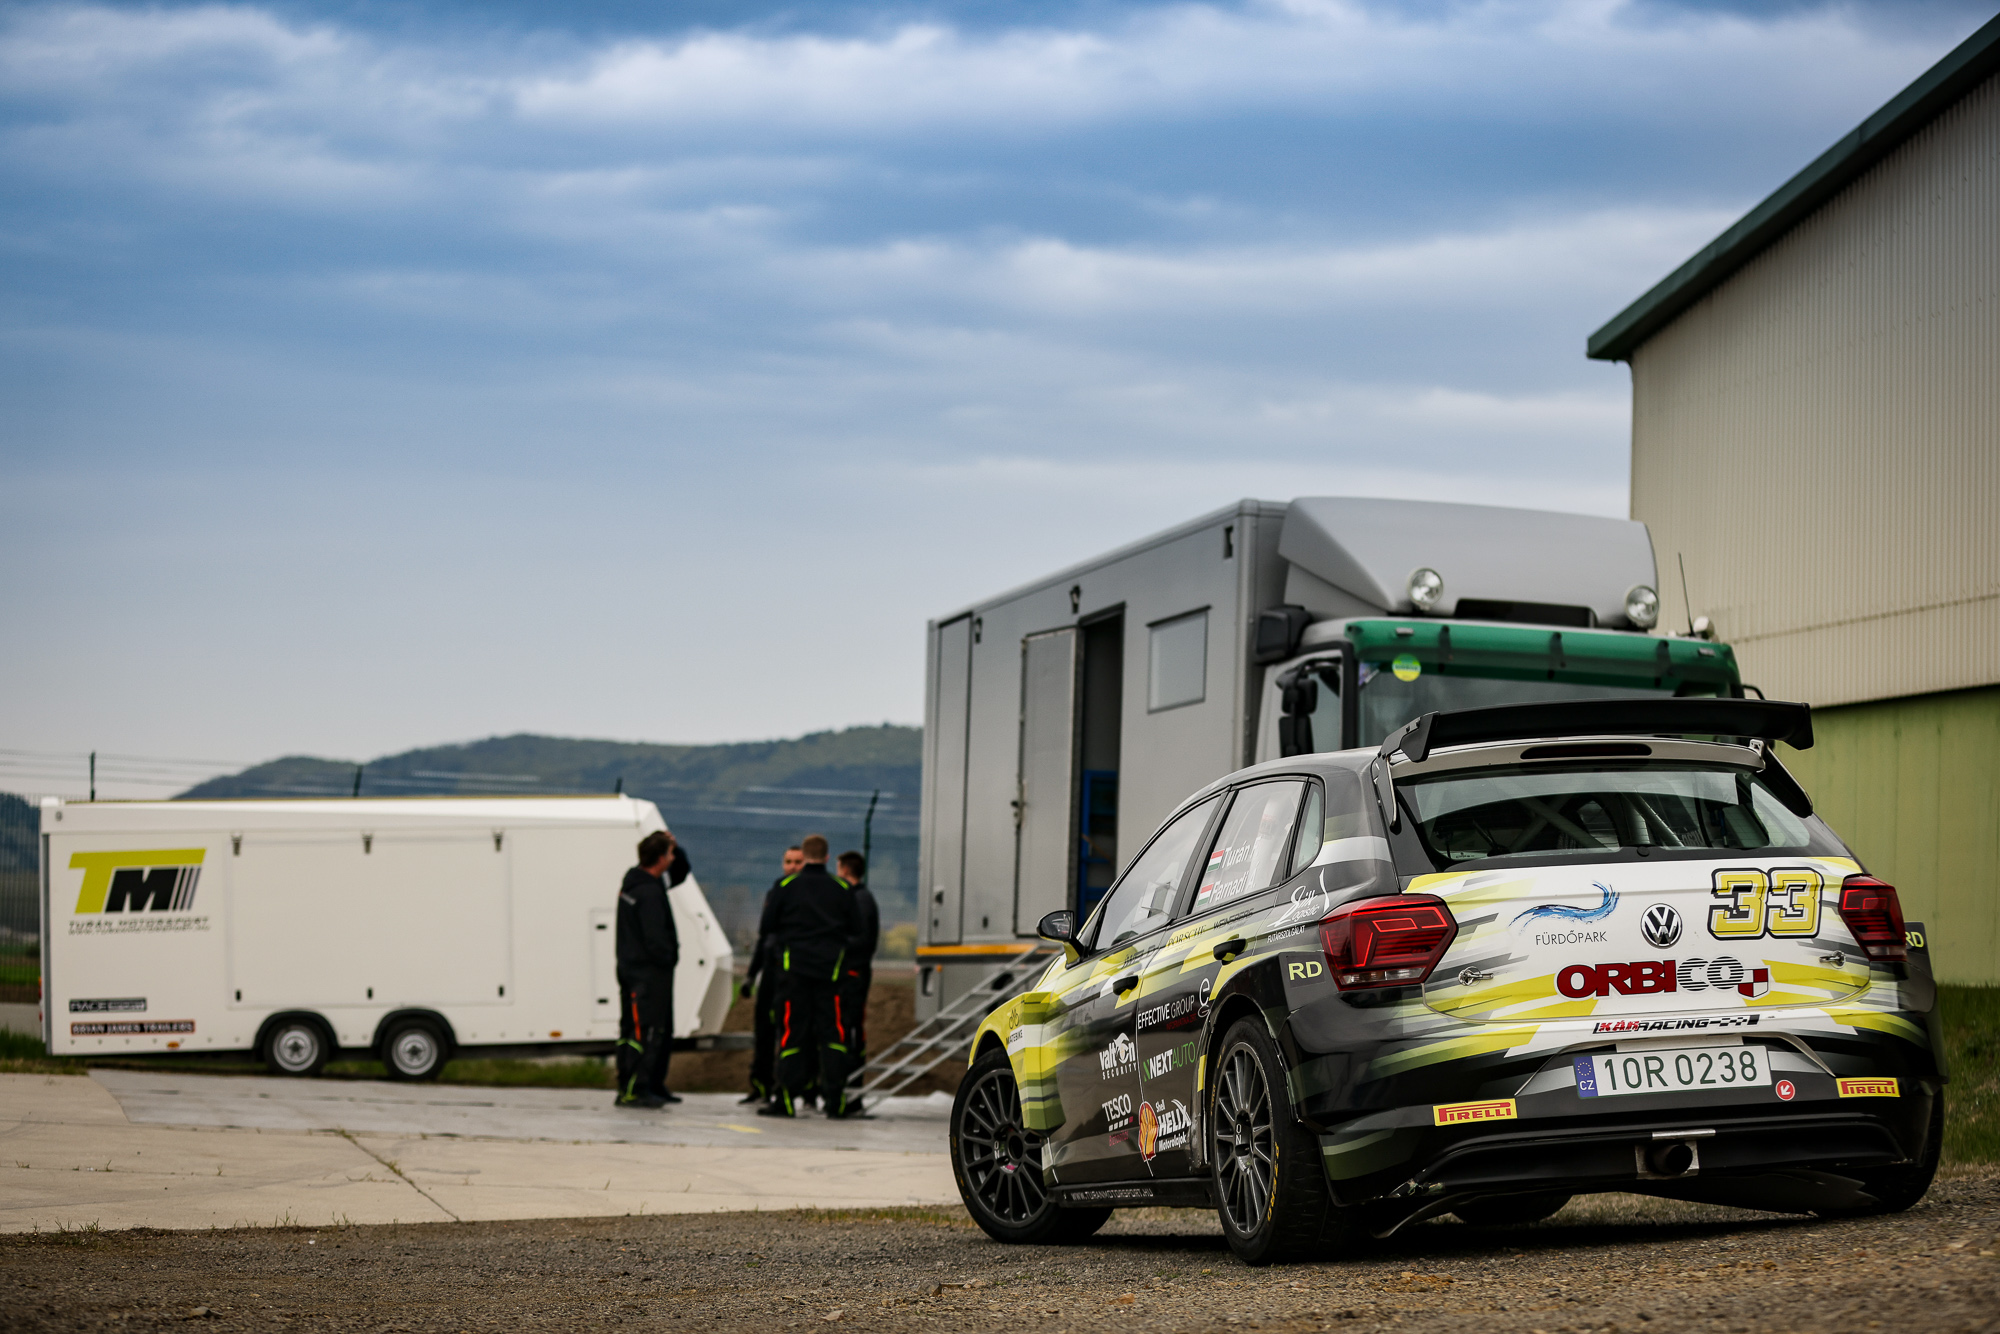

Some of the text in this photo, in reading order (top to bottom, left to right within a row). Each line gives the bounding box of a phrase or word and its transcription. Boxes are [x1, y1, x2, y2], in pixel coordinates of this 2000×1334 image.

[1222, 841, 1251, 869] Turán
[69, 848, 207, 914] TM
[1209, 871, 1250, 904] Farnadi
[1708, 867, 1825, 941] 33
[1166, 924, 1207, 948] PORSCHE
[1535, 930, 1607, 946] FÜRDŐPARK
[1288, 960, 1323, 981] RD
[1556, 956, 1745, 999] ORBICO
[1137, 994, 1195, 1030] EFFECTIVE GROUP
[1102, 1062, 1137, 1080] SECURITY
[1604, 1050, 1758, 1091] 10R 0238
[1579, 1079, 1595, 1091] CZ
[1840, 1080, 1896, 1095] PIRELLI
[1102, 1093, 1132, 1122] TESCO
[1155, 1099, 1166, 1113] Shell
[1157, 1099, 1192, 1138] HELIX
[1438, 1102, 1512, 1122] PIRELLI
[1158, 1131, 1187, 1152] Motorolajok
